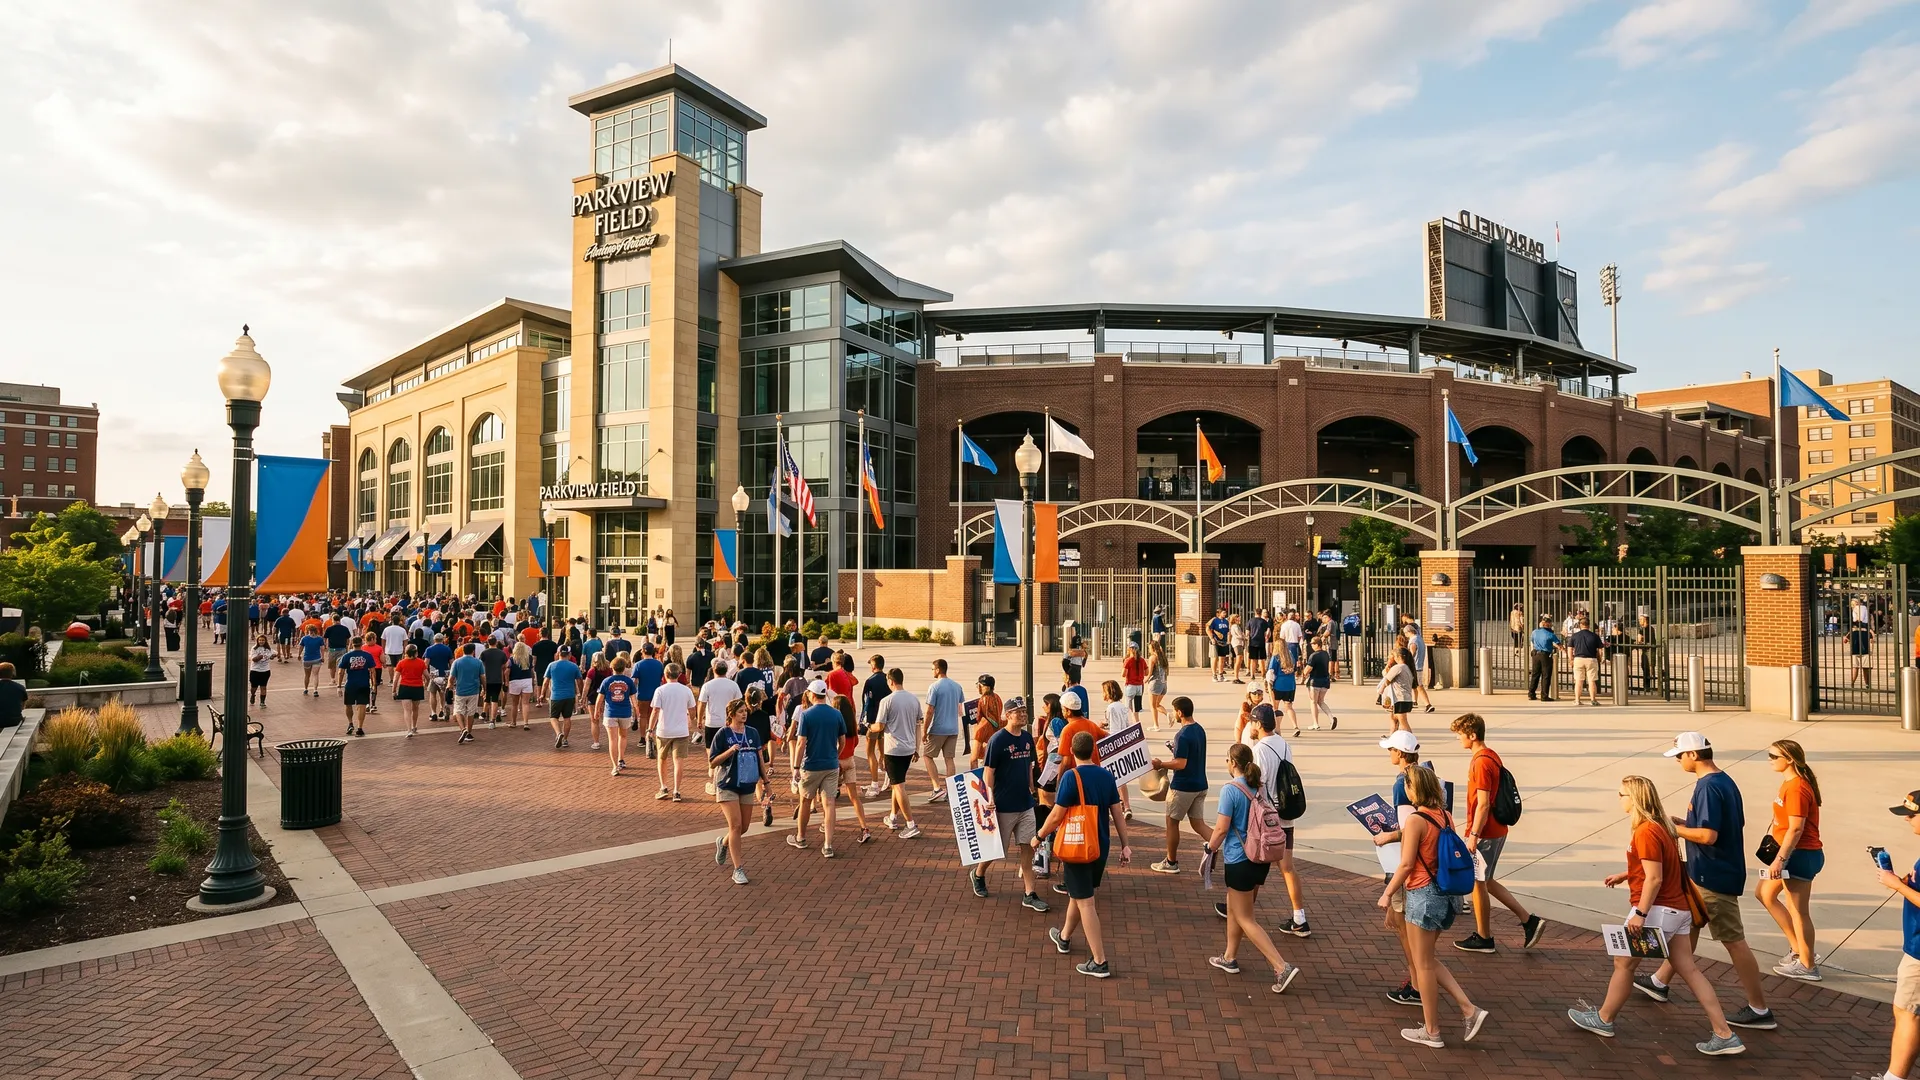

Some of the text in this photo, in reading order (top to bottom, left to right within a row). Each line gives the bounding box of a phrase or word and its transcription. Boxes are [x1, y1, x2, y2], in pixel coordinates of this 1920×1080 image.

[571, 171, 673, 217] PARKVIEW
[595, 205, 649, 236] FIELD
[539, 481, 636, 499] PARKVIEW FIELD
